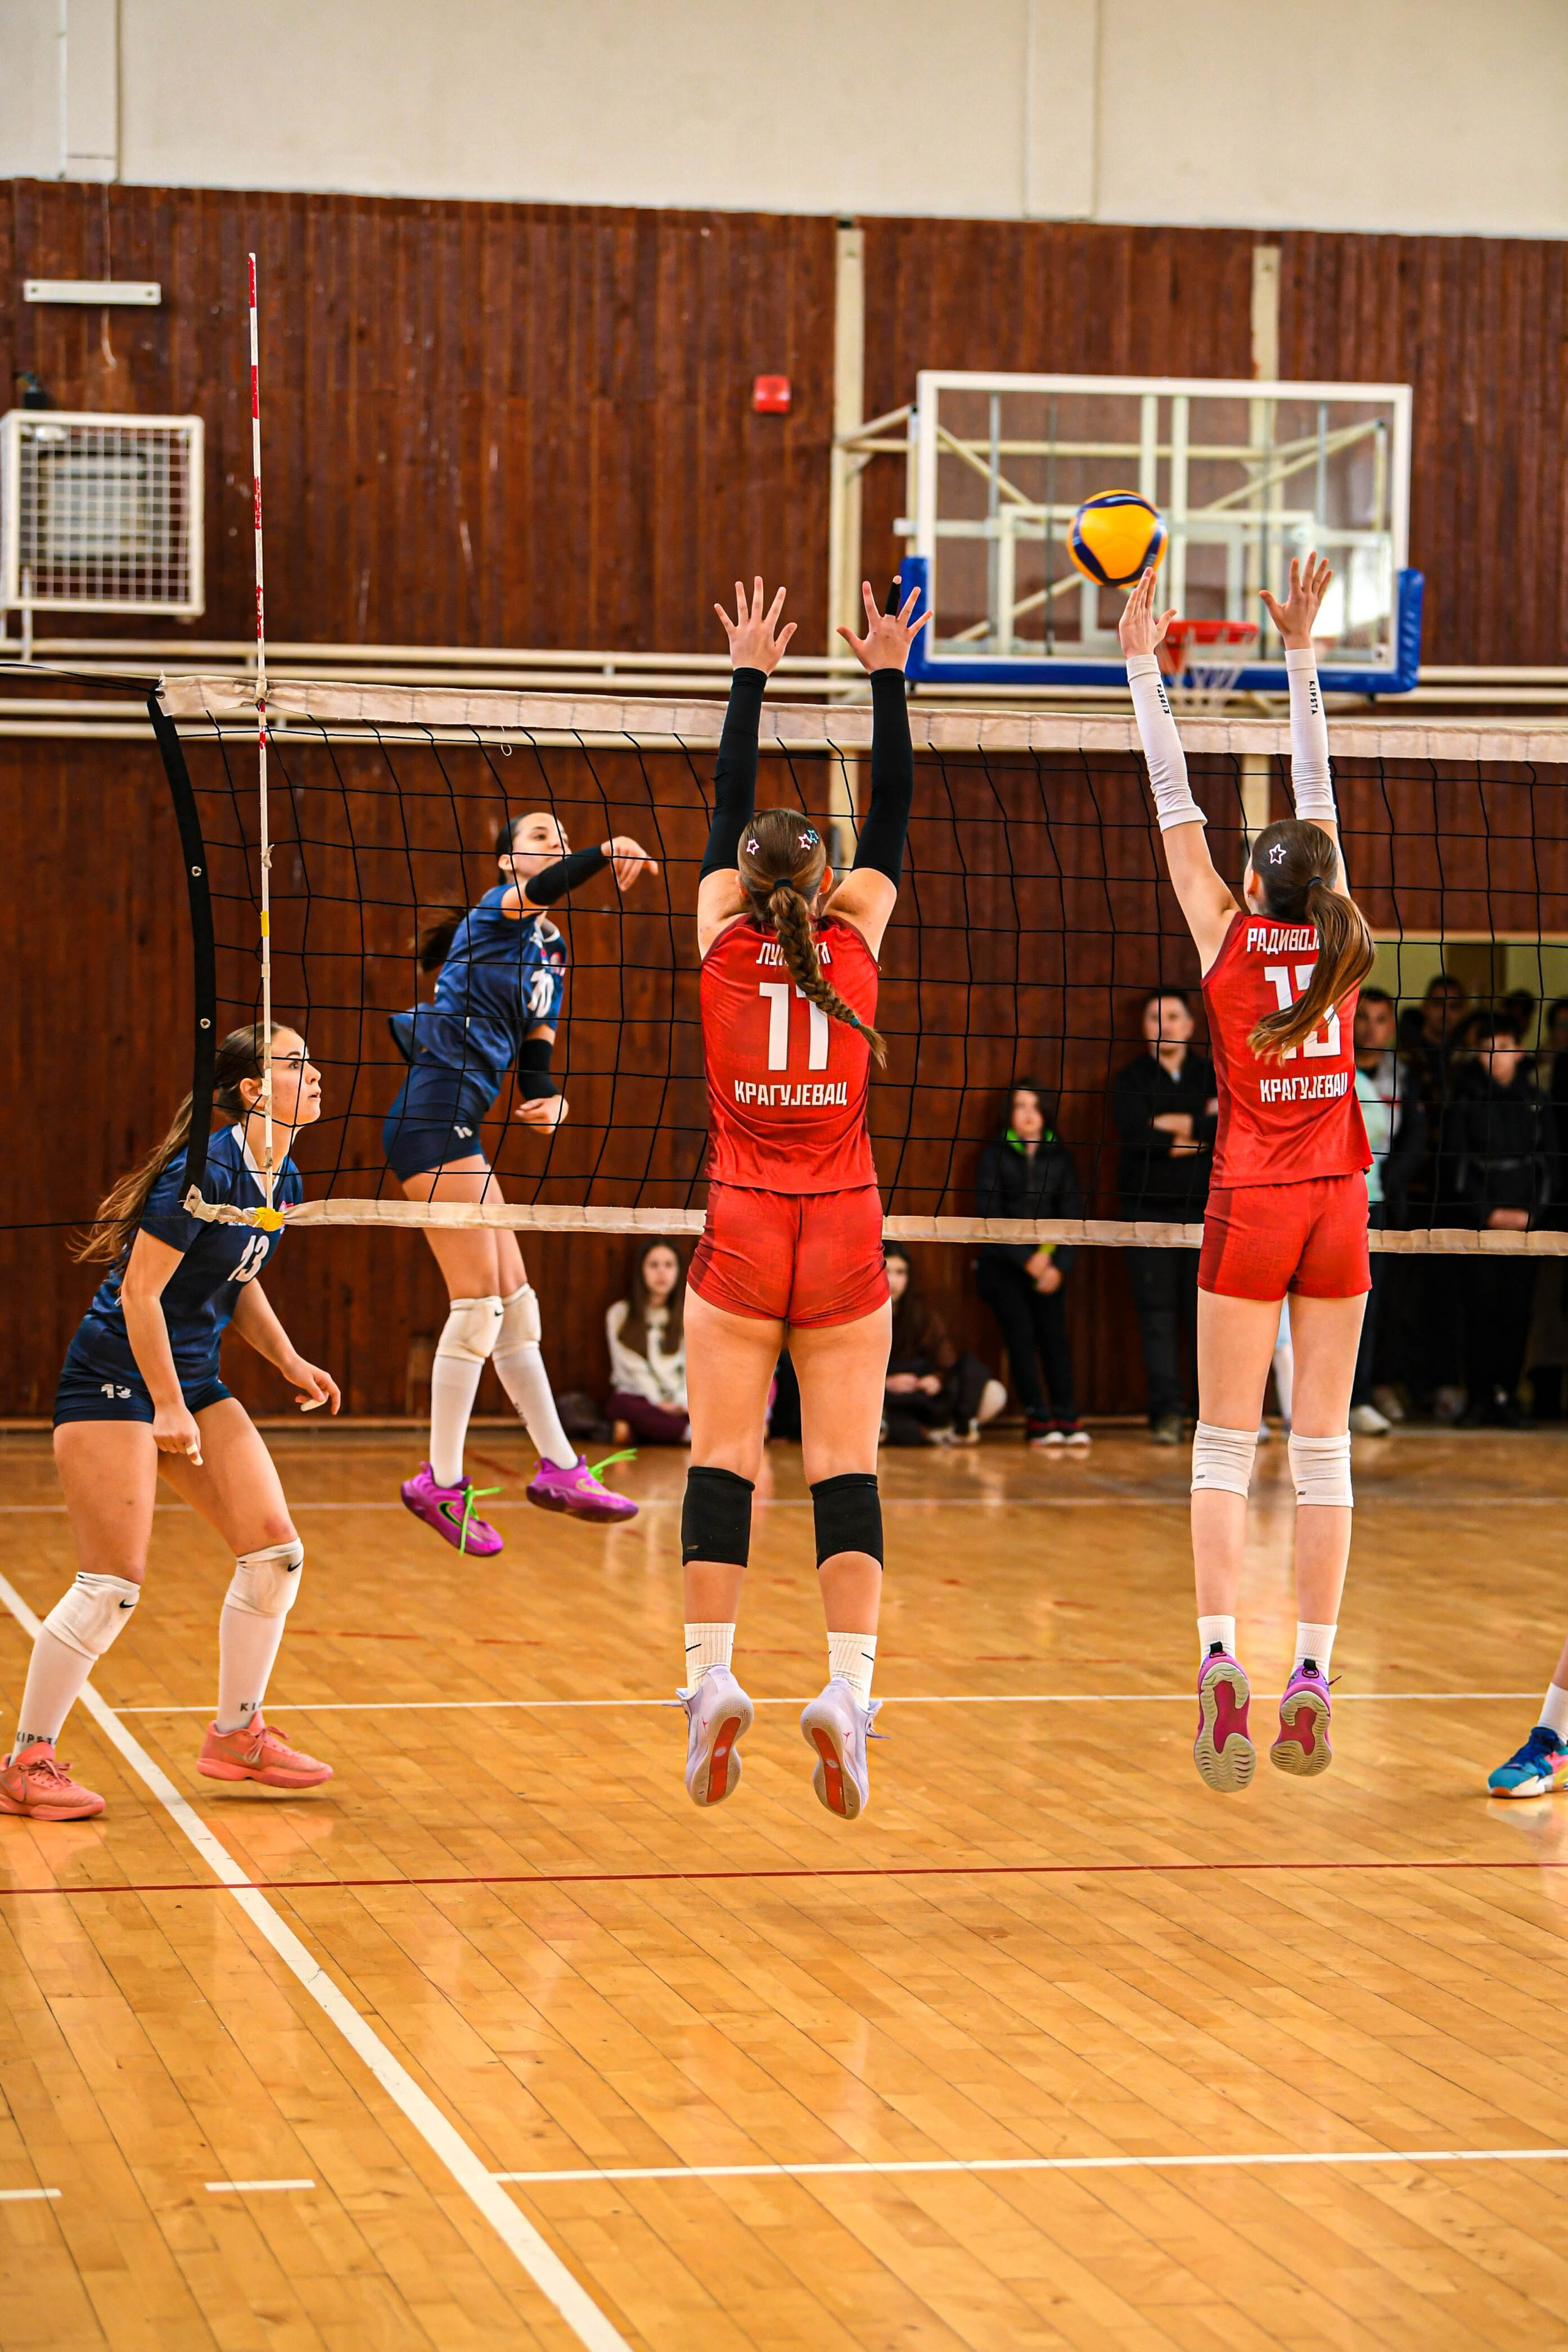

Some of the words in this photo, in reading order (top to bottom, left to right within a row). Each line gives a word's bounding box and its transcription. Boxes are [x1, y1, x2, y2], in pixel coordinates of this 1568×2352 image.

[1156, 684, 1170, 714] KIPSTA
[1309, 680, 1318, 715] KIPSTA
[1246, 928, 1320, 955] РАДИВОЈ
[759, 982, 829, 1071] 11
[734, 1079, 848, 1106] КРАГУЈЕВАЦ
[227, 1235, 270, 1282] 13
[17, 1732, 58, 1745] KIPST
